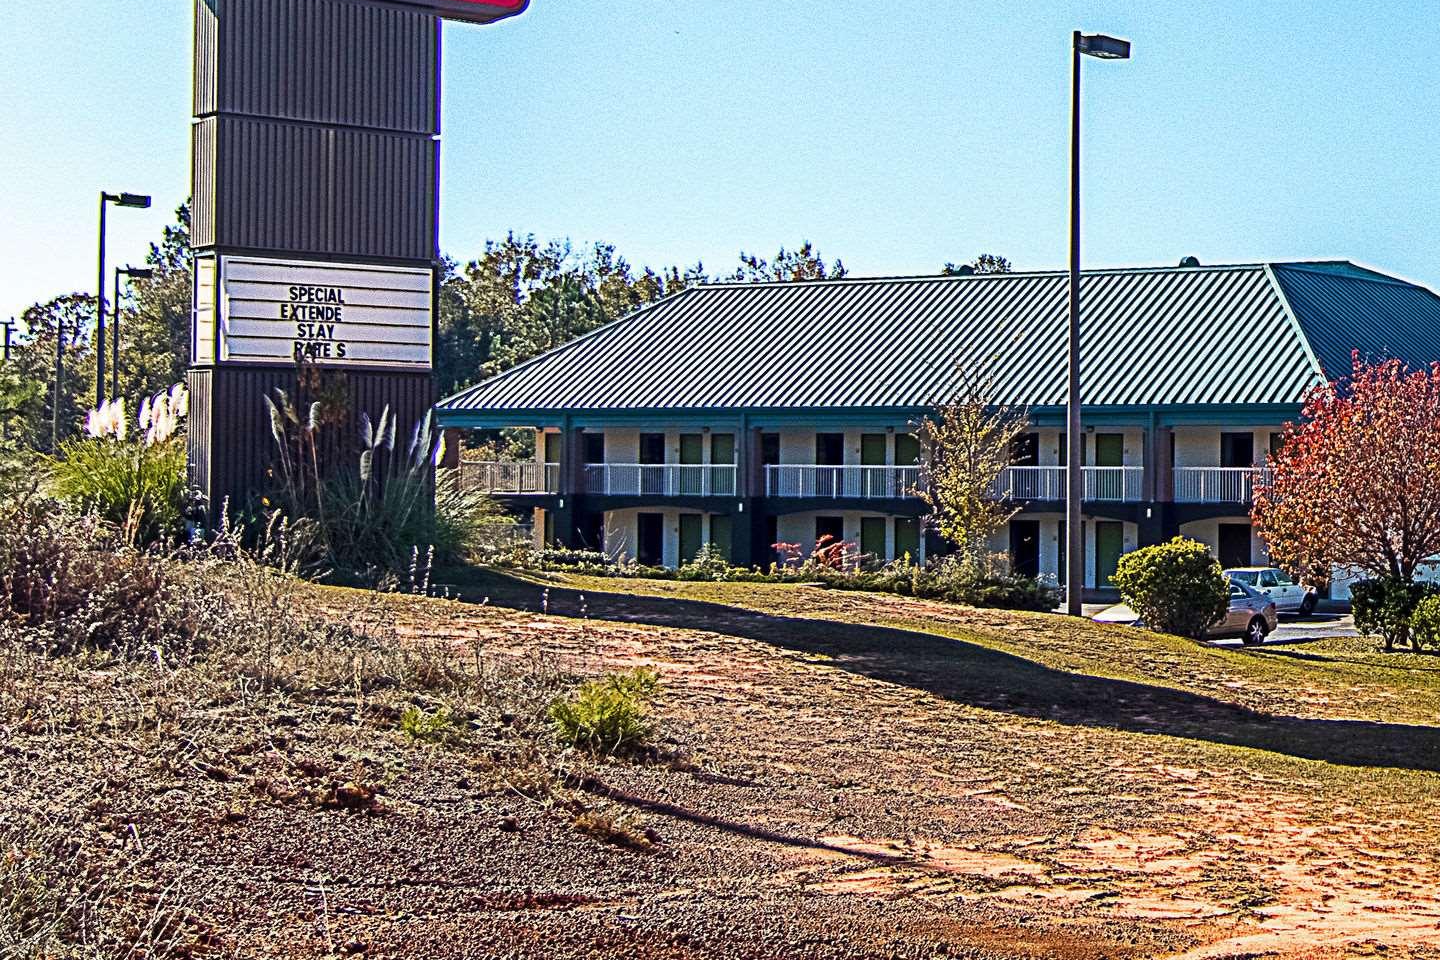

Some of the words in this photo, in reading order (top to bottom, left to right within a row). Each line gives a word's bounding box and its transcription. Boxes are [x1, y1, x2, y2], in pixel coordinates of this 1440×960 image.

[289, 286, 345, 304] SPECIAL
[281, 303, 342, 322] EXTENDE
[297, 323, 334, 339] STAY
